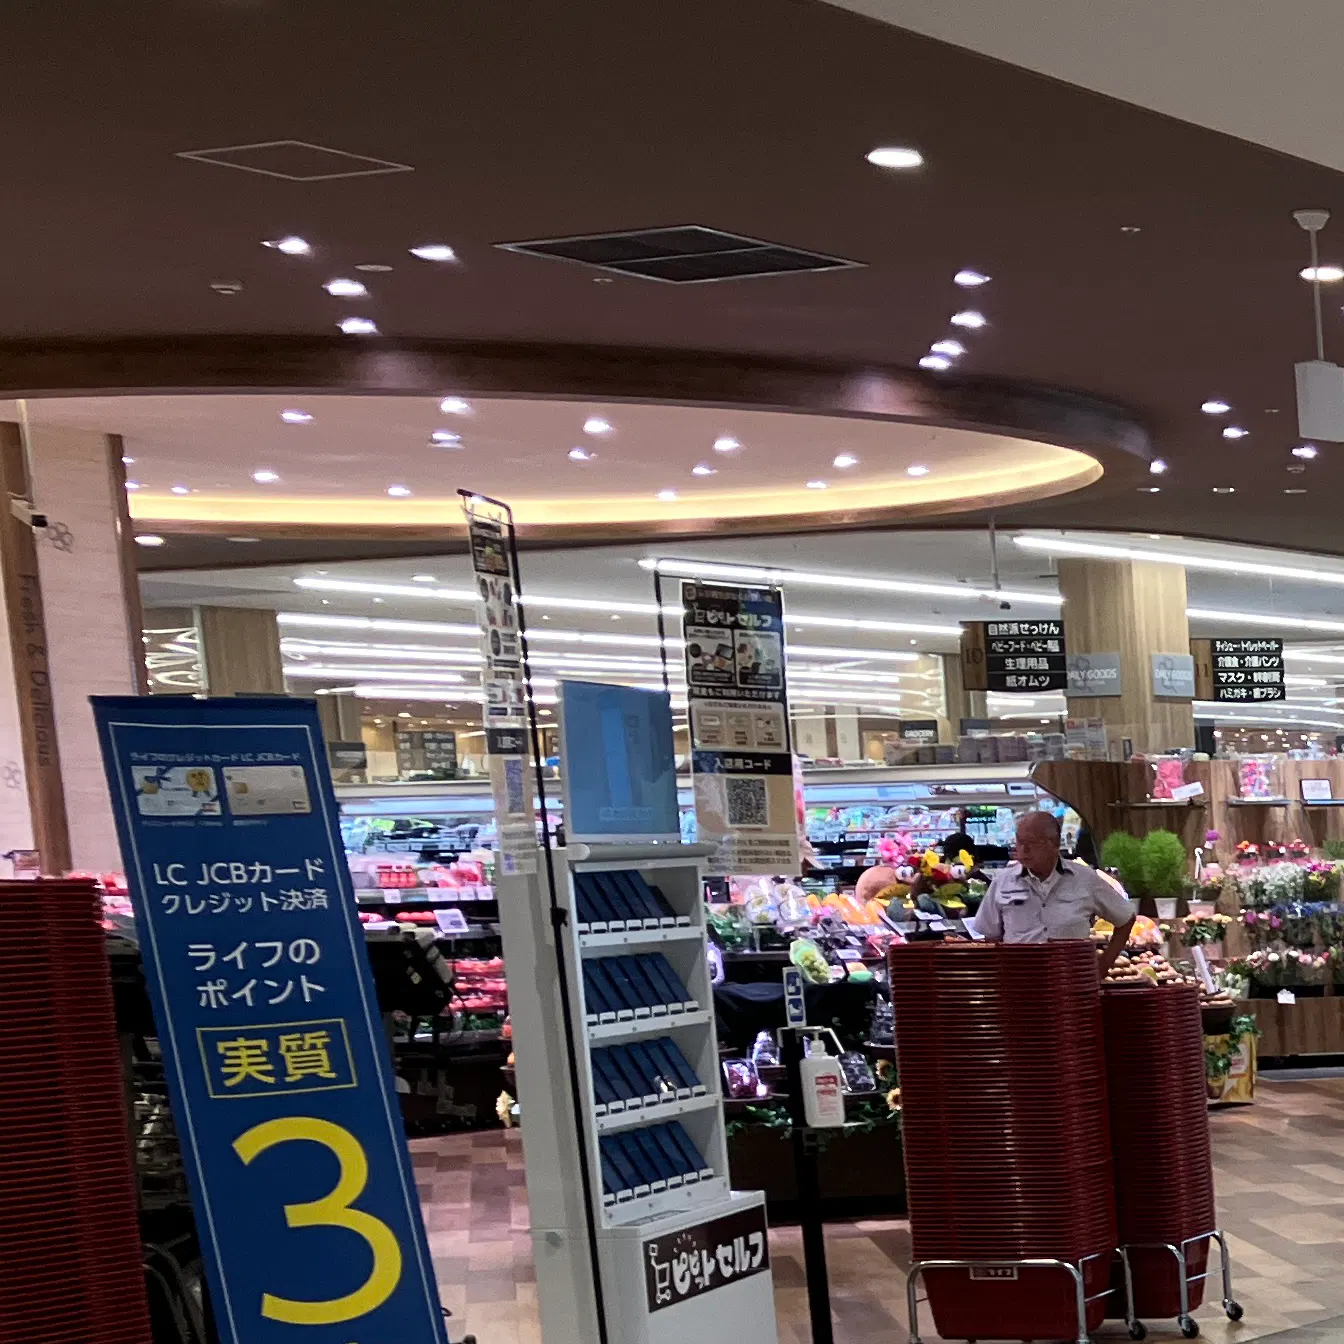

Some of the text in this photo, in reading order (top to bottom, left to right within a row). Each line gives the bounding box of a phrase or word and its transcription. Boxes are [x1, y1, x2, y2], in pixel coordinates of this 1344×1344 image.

[988, 622, 1060, 636] 自然派せっけん
[1004, 658, 1049, 670] 生理用品
[1087, 668, 1117, 679] GOODS
[1005, 675, 1050, 688] 紙オムツ
[1220, 688, 1281, 699] ハミガキ・歯ブラシ
[153, 858, 325, 886] LC JCBカード
[161, 888, 329, 914] クレジット決済
[188, 938, 320, 971] ライフの
[196, 975, 326, 1008] ポイント
[216, 1031, 337, 1087] 実質
[232, 1117, 402, 1325] 3
